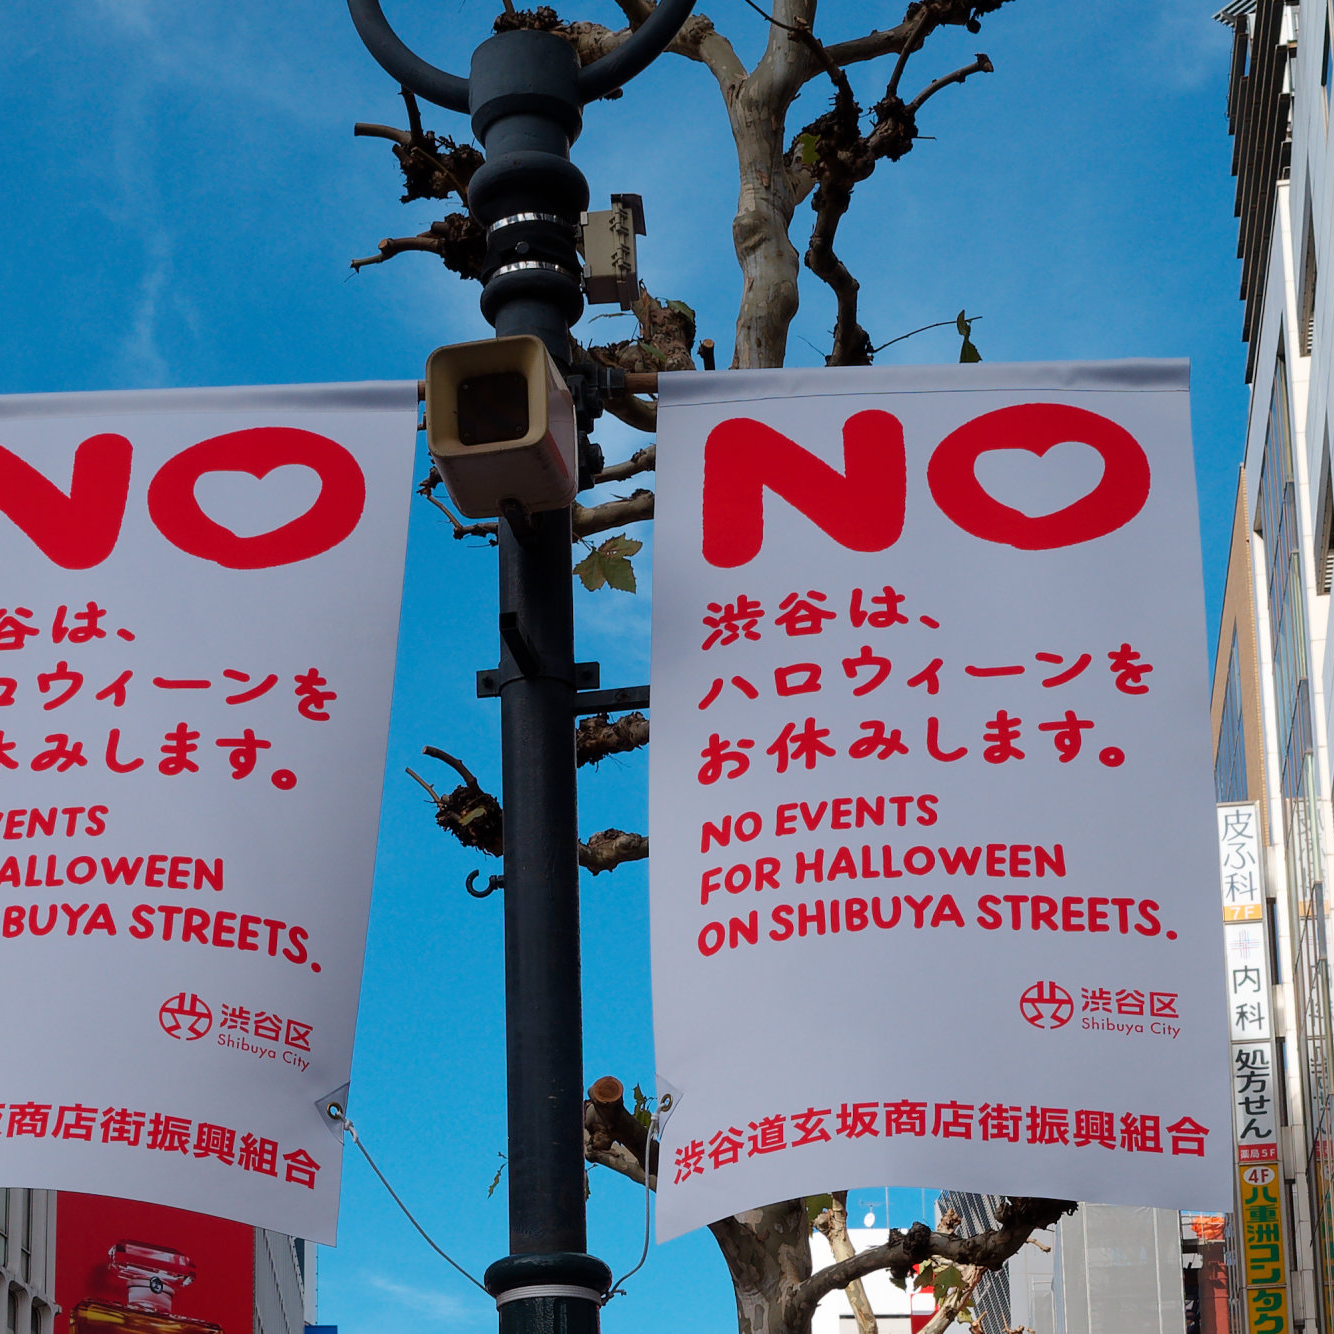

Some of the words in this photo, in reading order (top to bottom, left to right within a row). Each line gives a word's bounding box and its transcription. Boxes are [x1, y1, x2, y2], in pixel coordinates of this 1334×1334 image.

[702, 403, 1151, 568] NO
[701, 586, 940, 651] 渋谷は、
[697, 643, 1154, 710] ハロウィーンを
[697, 710, 1126, 785] お休みします。
[701, 811, 762, 853] NO
[775, 794, 939, 837] EVENTS
[1221, 809, 1258, 902] 皮ふ科
[700, 857, 781, 905] FOR
[795, 844, 1066, 884] HALLOWEEN
[128, 906, 322, 973] STREETS.
[697, 909, 759, 957] ON
[769, 893, 965, 942] SHIBUYA
[975, 894, 1178, 941] STREETS.
[1230, 905, 1255, 920] 7F
[219, 1002, 312, 1053] 渋谷区
[1080, 987, 1180, 1019] 渋谷区
[1081, 1016, 1146, 1036] Shibuya
[1150, 1017, 1181, 1040] City
[1232, 965, 1266, 1031] 内科
[217, 1032, 277, 1062] Shibuya
[281, 1049, 311, 1072] City
[1234, 1048, 1273, 1141] 処方せん
[672, 1099, 1210, 1186] 渋谷道玄坂商店街振興組合
[1248, 1168, 1270, 1183] 4F
